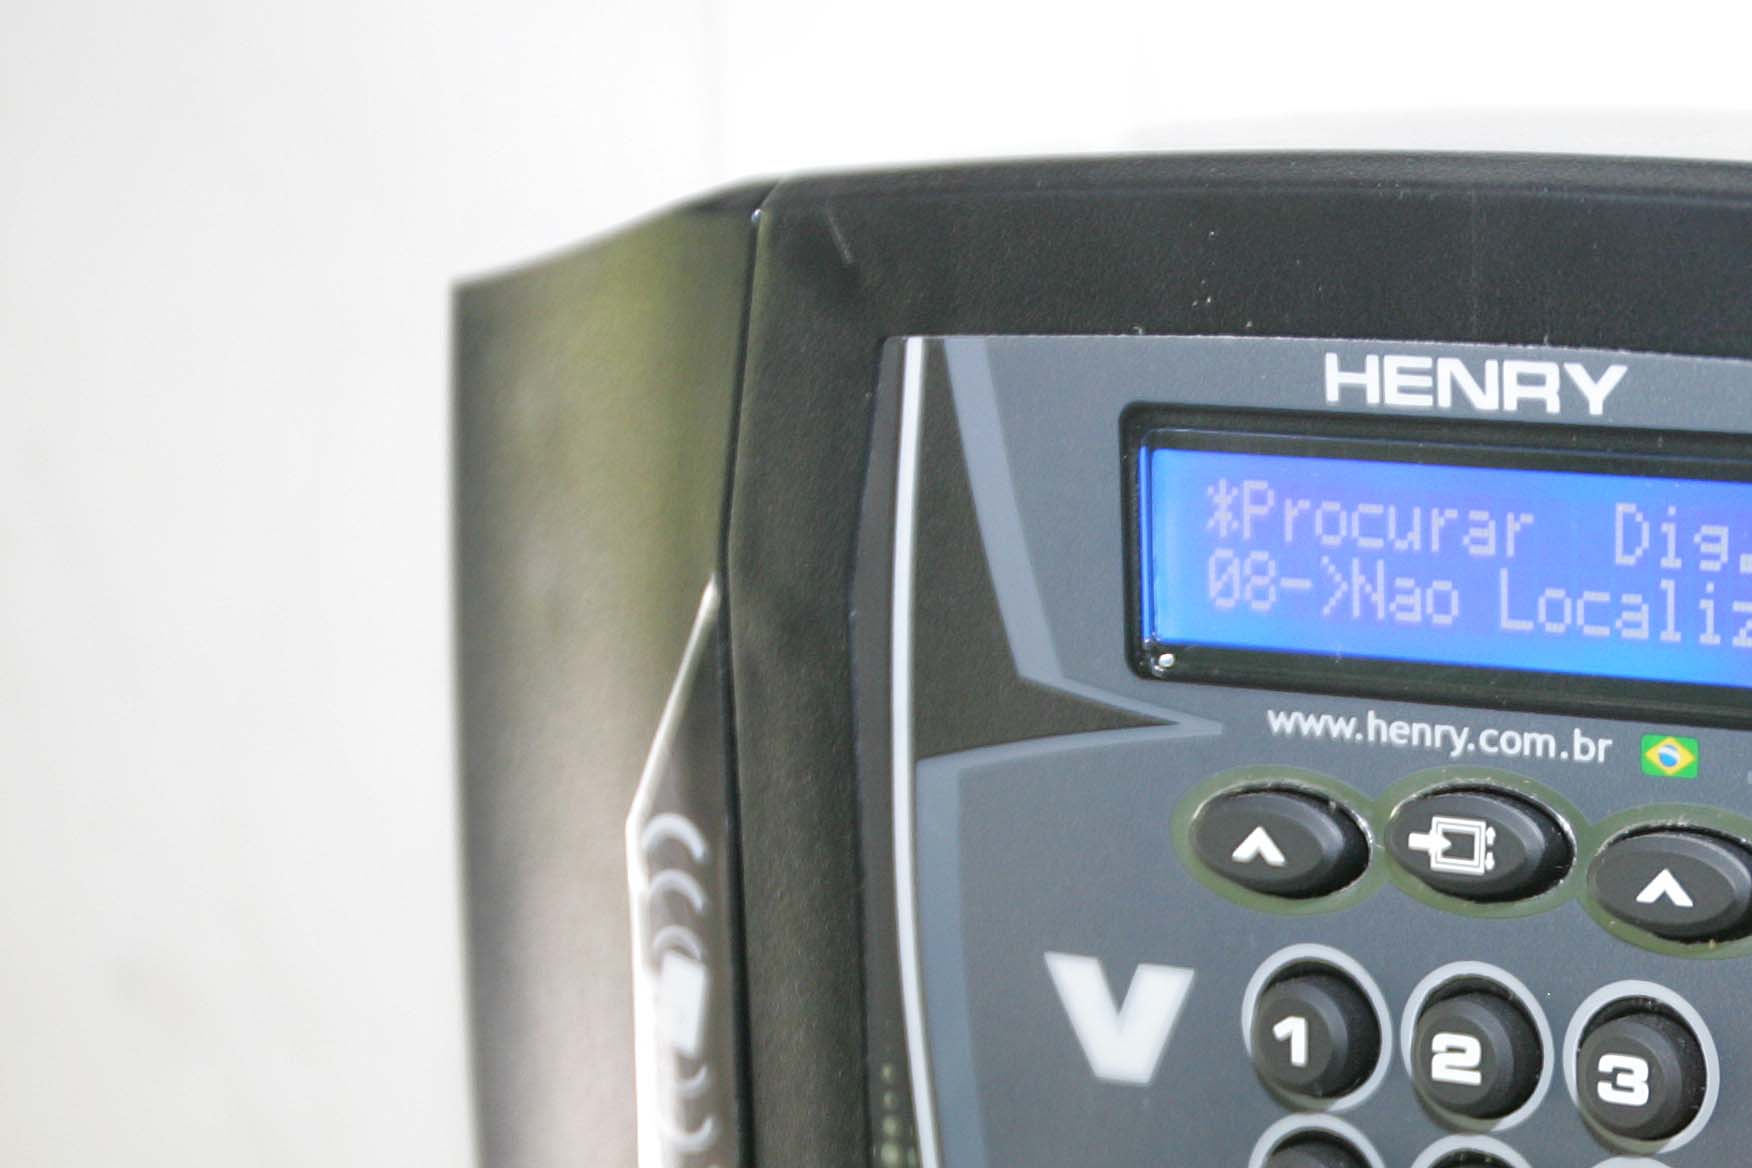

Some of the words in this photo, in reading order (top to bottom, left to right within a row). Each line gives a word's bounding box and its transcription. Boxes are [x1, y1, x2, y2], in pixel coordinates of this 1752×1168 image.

[1323, 353, 1629, 417] HENRY
[1267, 709, 1614, 764] www.henry.com.br
[1273, 1016, 1309, 1066] 1
[1431, 1033, 1482, 1086] 2
[1596, 1053, 1650, 1107] 3
